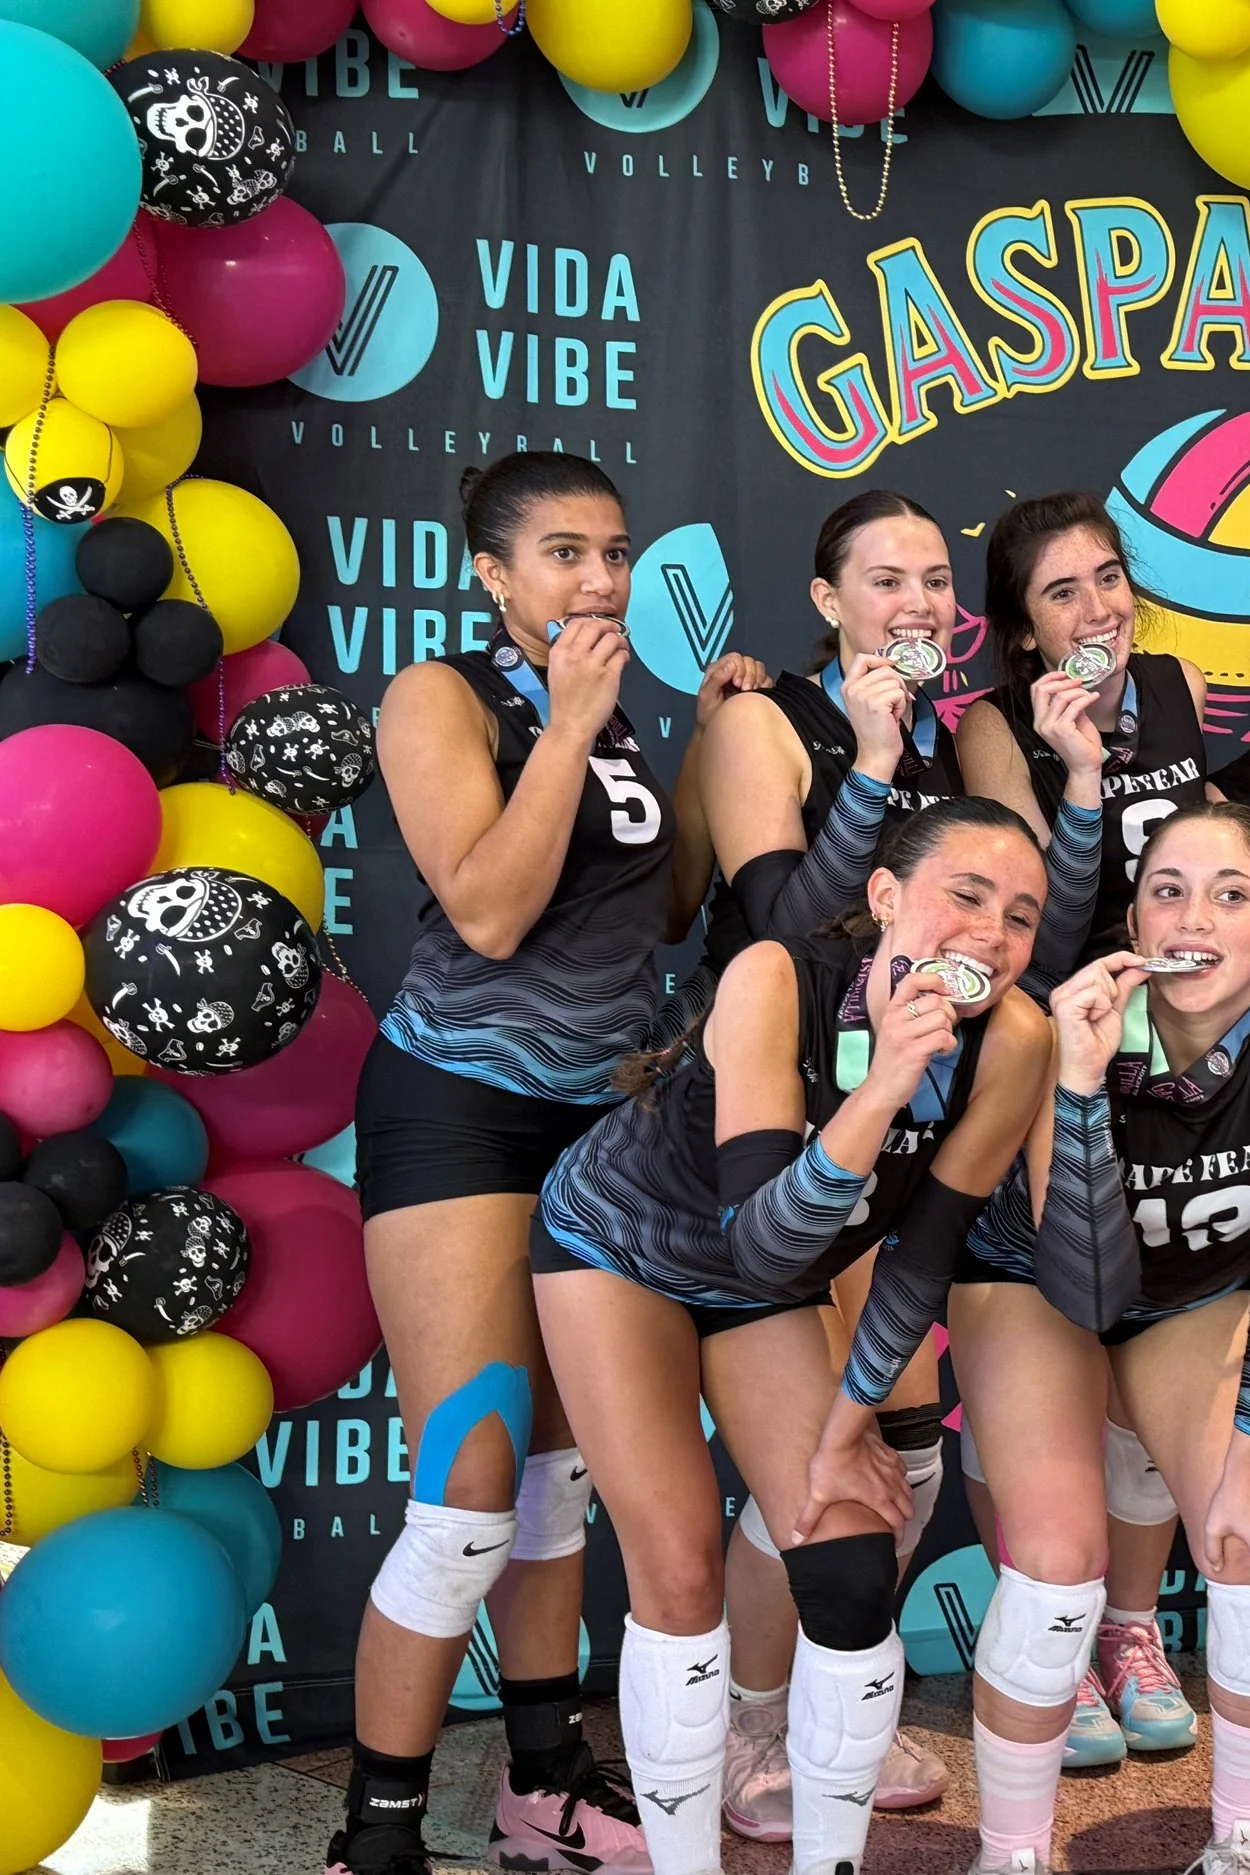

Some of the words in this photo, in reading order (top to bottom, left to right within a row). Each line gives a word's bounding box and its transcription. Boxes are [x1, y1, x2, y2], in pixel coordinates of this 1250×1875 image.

[476, 239, 641, 323] VIDA
[477, 330, 638, 410] VIBE
[588, 756, 662, 845] 5
